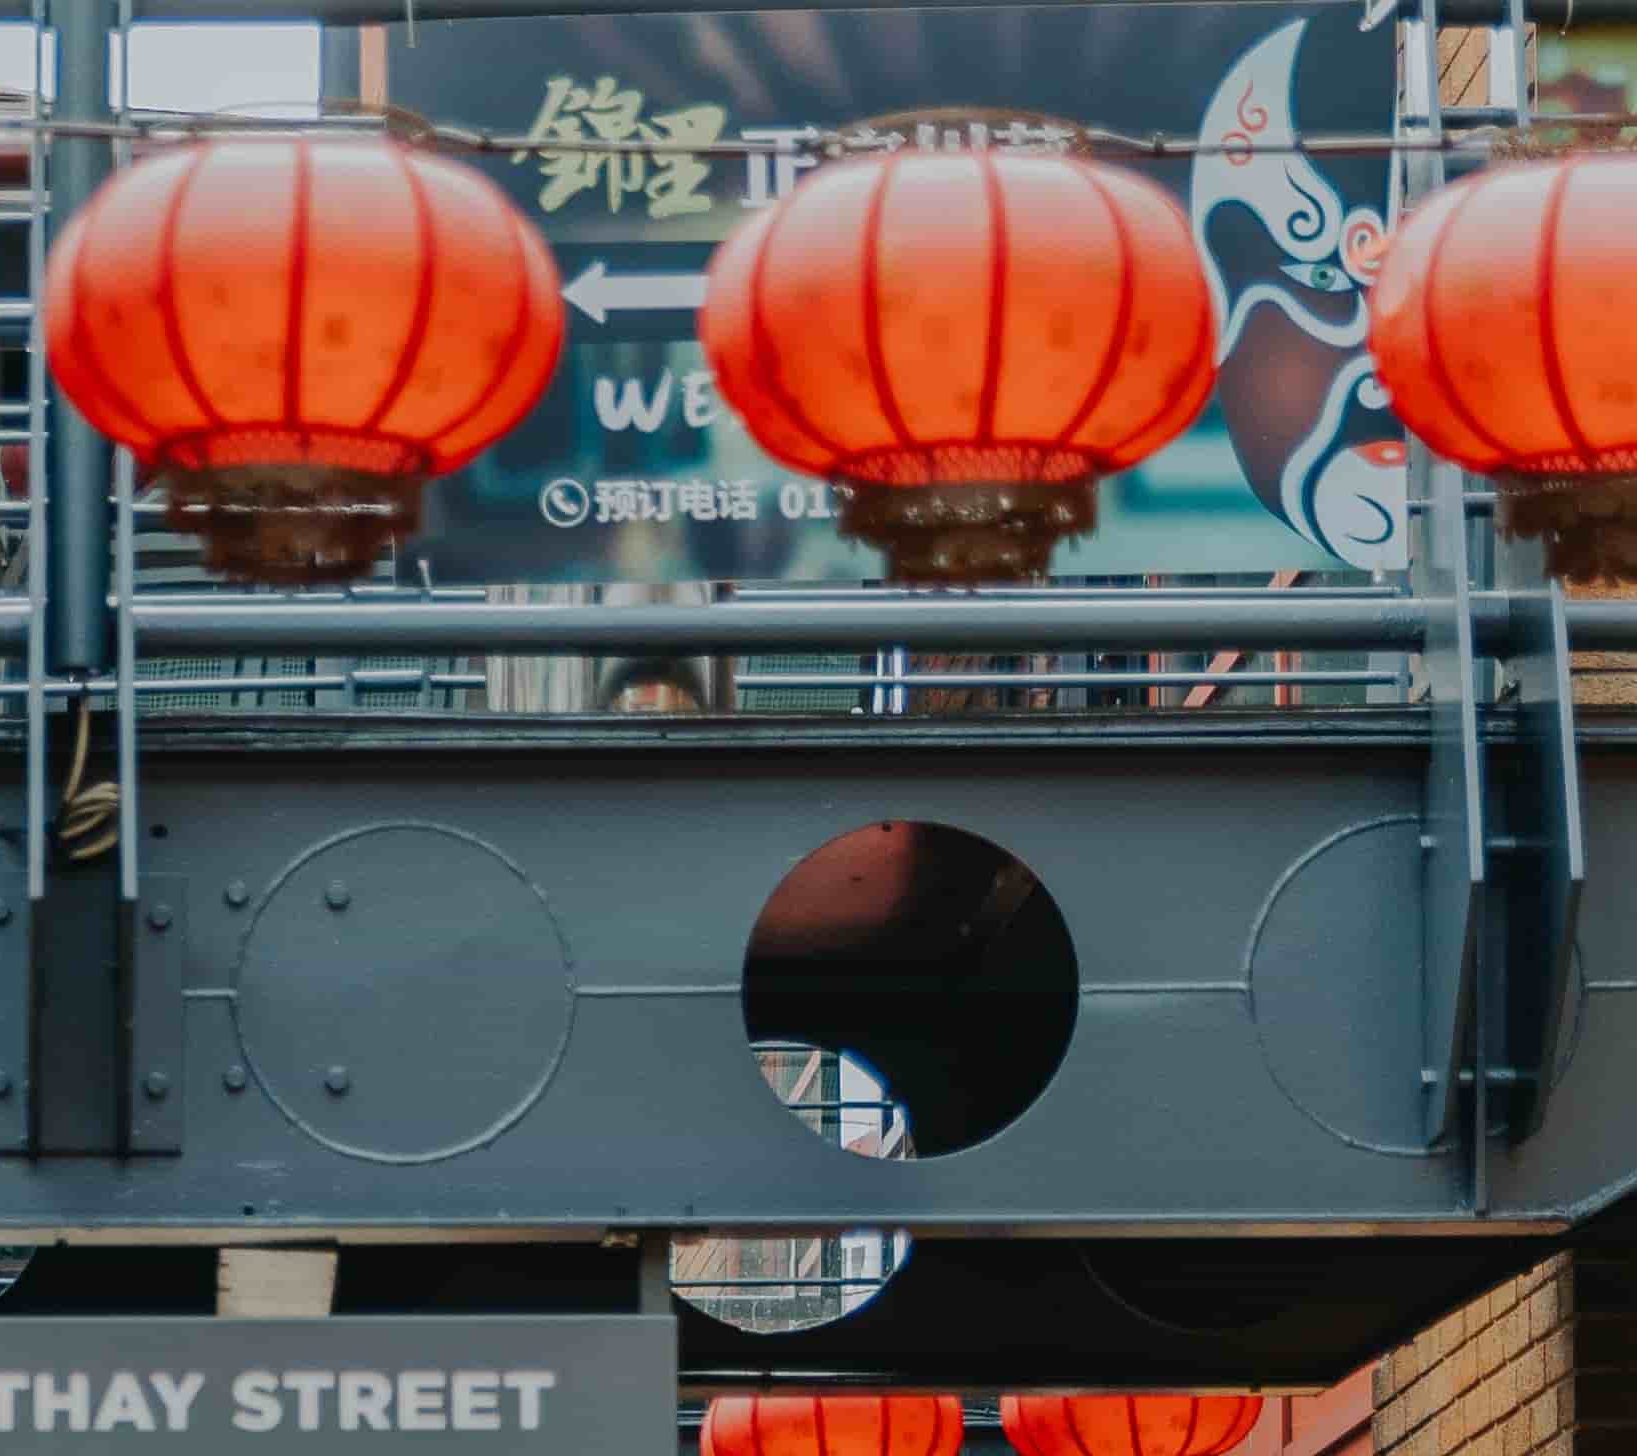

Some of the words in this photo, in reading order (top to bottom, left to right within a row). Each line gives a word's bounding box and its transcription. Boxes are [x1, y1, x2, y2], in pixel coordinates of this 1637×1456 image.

[593, 479, 758, 523] 预订电话
[230, 1370, 556, 1434] STREET
